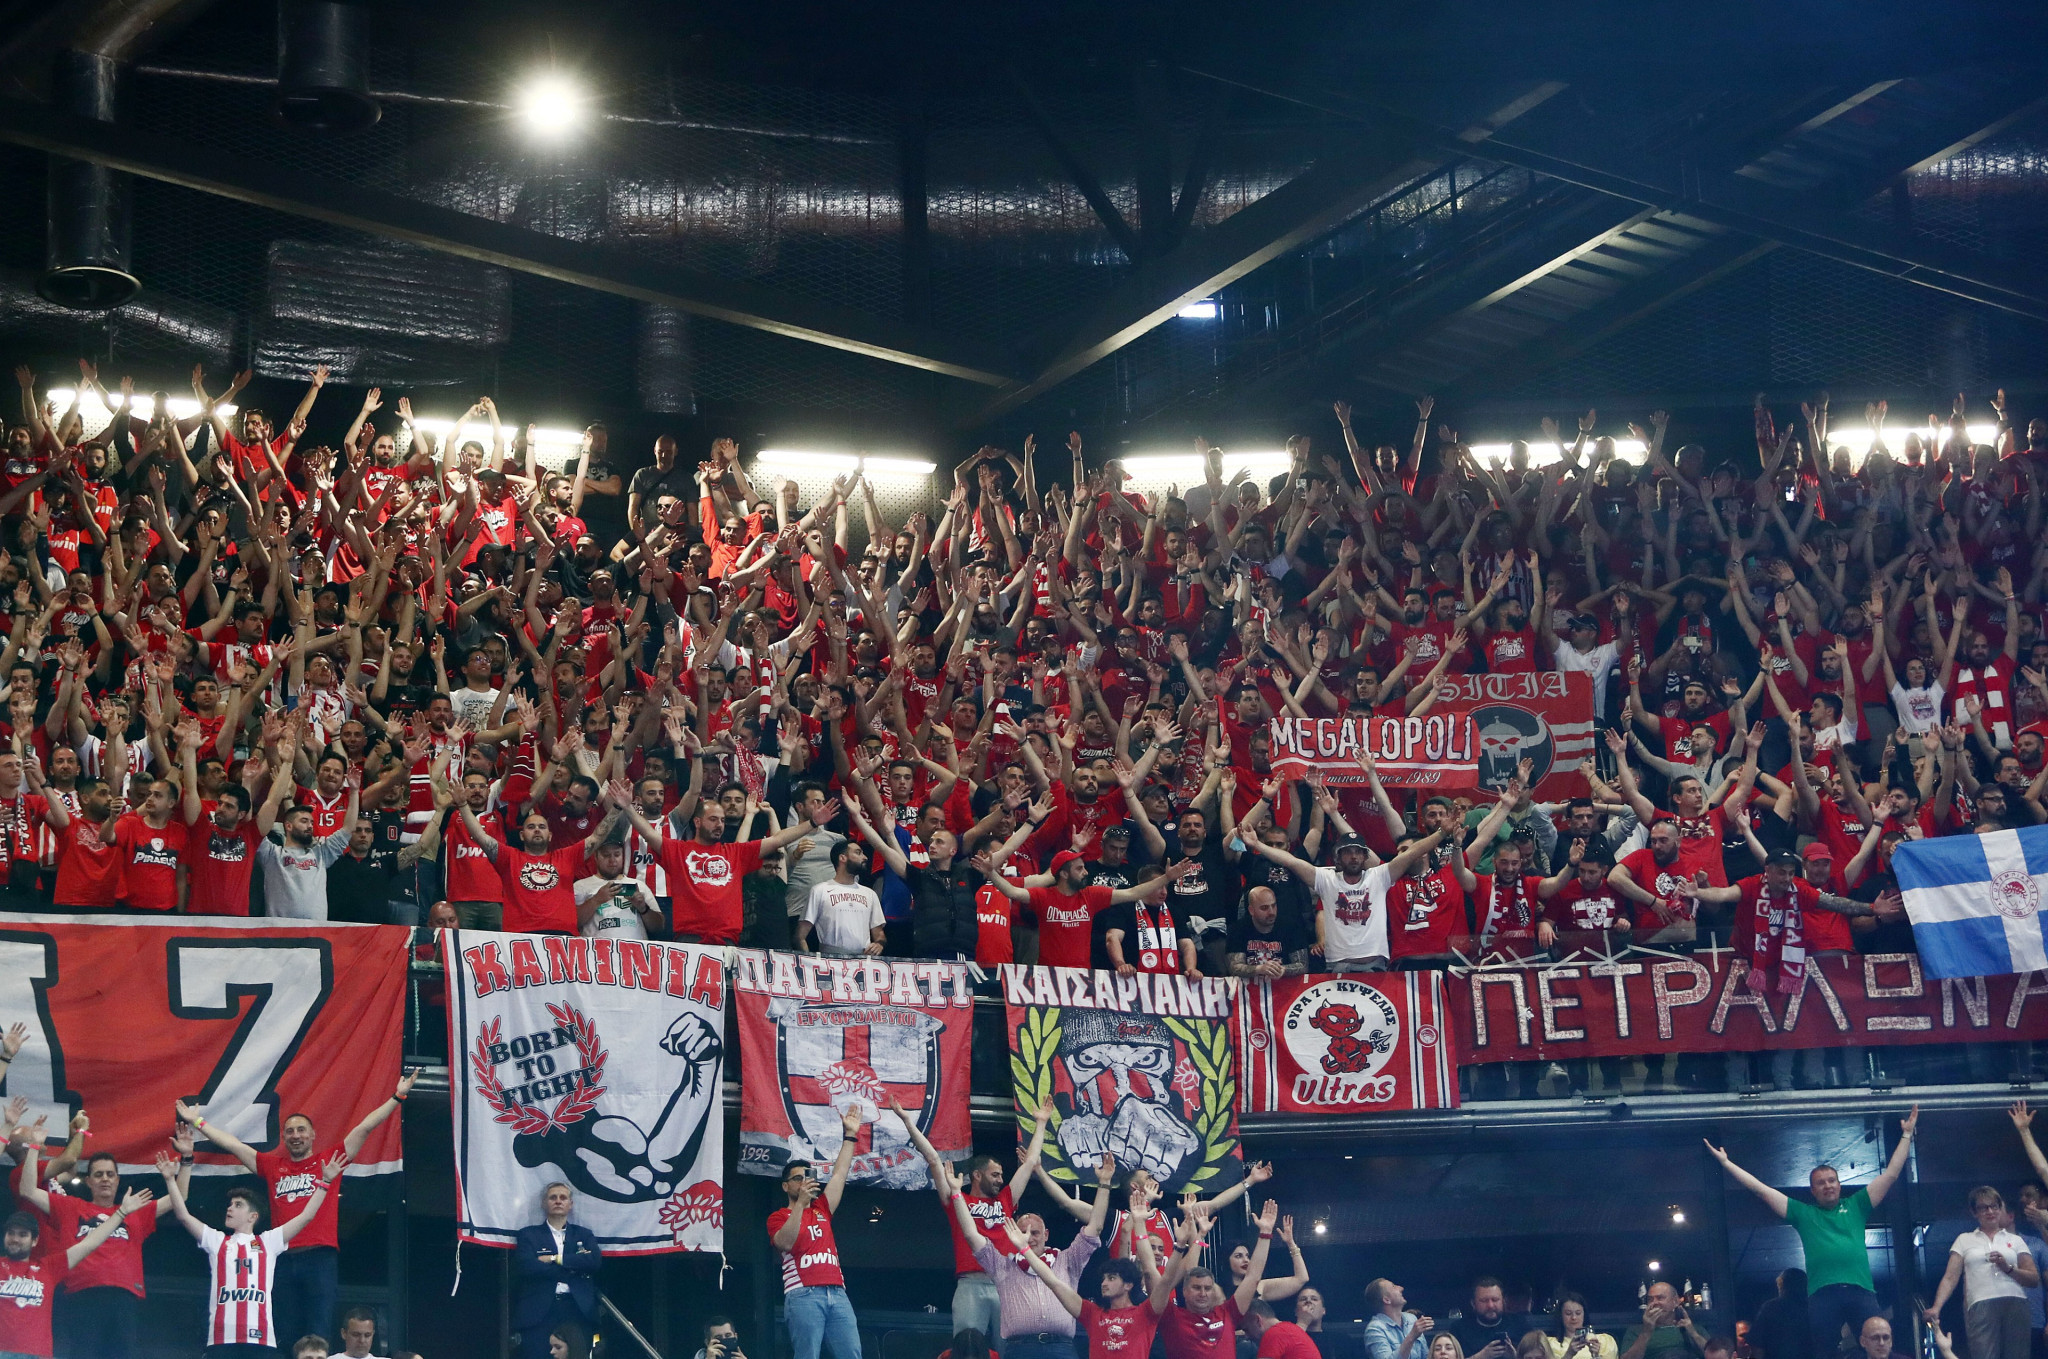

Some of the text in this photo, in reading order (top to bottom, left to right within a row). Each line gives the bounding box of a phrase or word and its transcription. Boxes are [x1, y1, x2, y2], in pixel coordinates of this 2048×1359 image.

[1437, 671, 1570, 702] SITIA
[1270, 713, 1473, 761] MEGALOPOLI
[1327, 772, 1366, 784] miners
[1405, 771, 1441, 784] 1989
[318, 812, 335, 828] 15
[133, 851, 177, 870] PIRAEUS
[982, 891, 992, 905] 7
[464, 937, 726, 1011] KAMINIA
[737, 948, 972, 1009] ΠΑΓΚΡΑΤΙ
[1002, 963, 1230, 1018] ΚΑΙΣΑΡΙΑΝΗ
[1287, 996, 1312, 1030] ΘΥΡΑ
[1311, 988, 1321, 998] 7
[1336, 982, 1397, 1026] ΚΥΨΕΛΗΣ
[166, 936, 335, 1154] 7
[488, 1023, 580, 1066] BORN
[516, 1053, 557, 1082] TO
[500, 1066, 598, 1110] FIGHT
[740, 1144, 770, 1162] 1996
[275, 1177, 313, 1195] KAUNAS
[807, 1224, 823, 1241] 16
[234, 1258, 252, 1275] 14
[800, 1248, 839, 1269] bwin
[0, 1280, 44, 1297] KAUNAS
[218, 1283, 266, 1305] bwin
